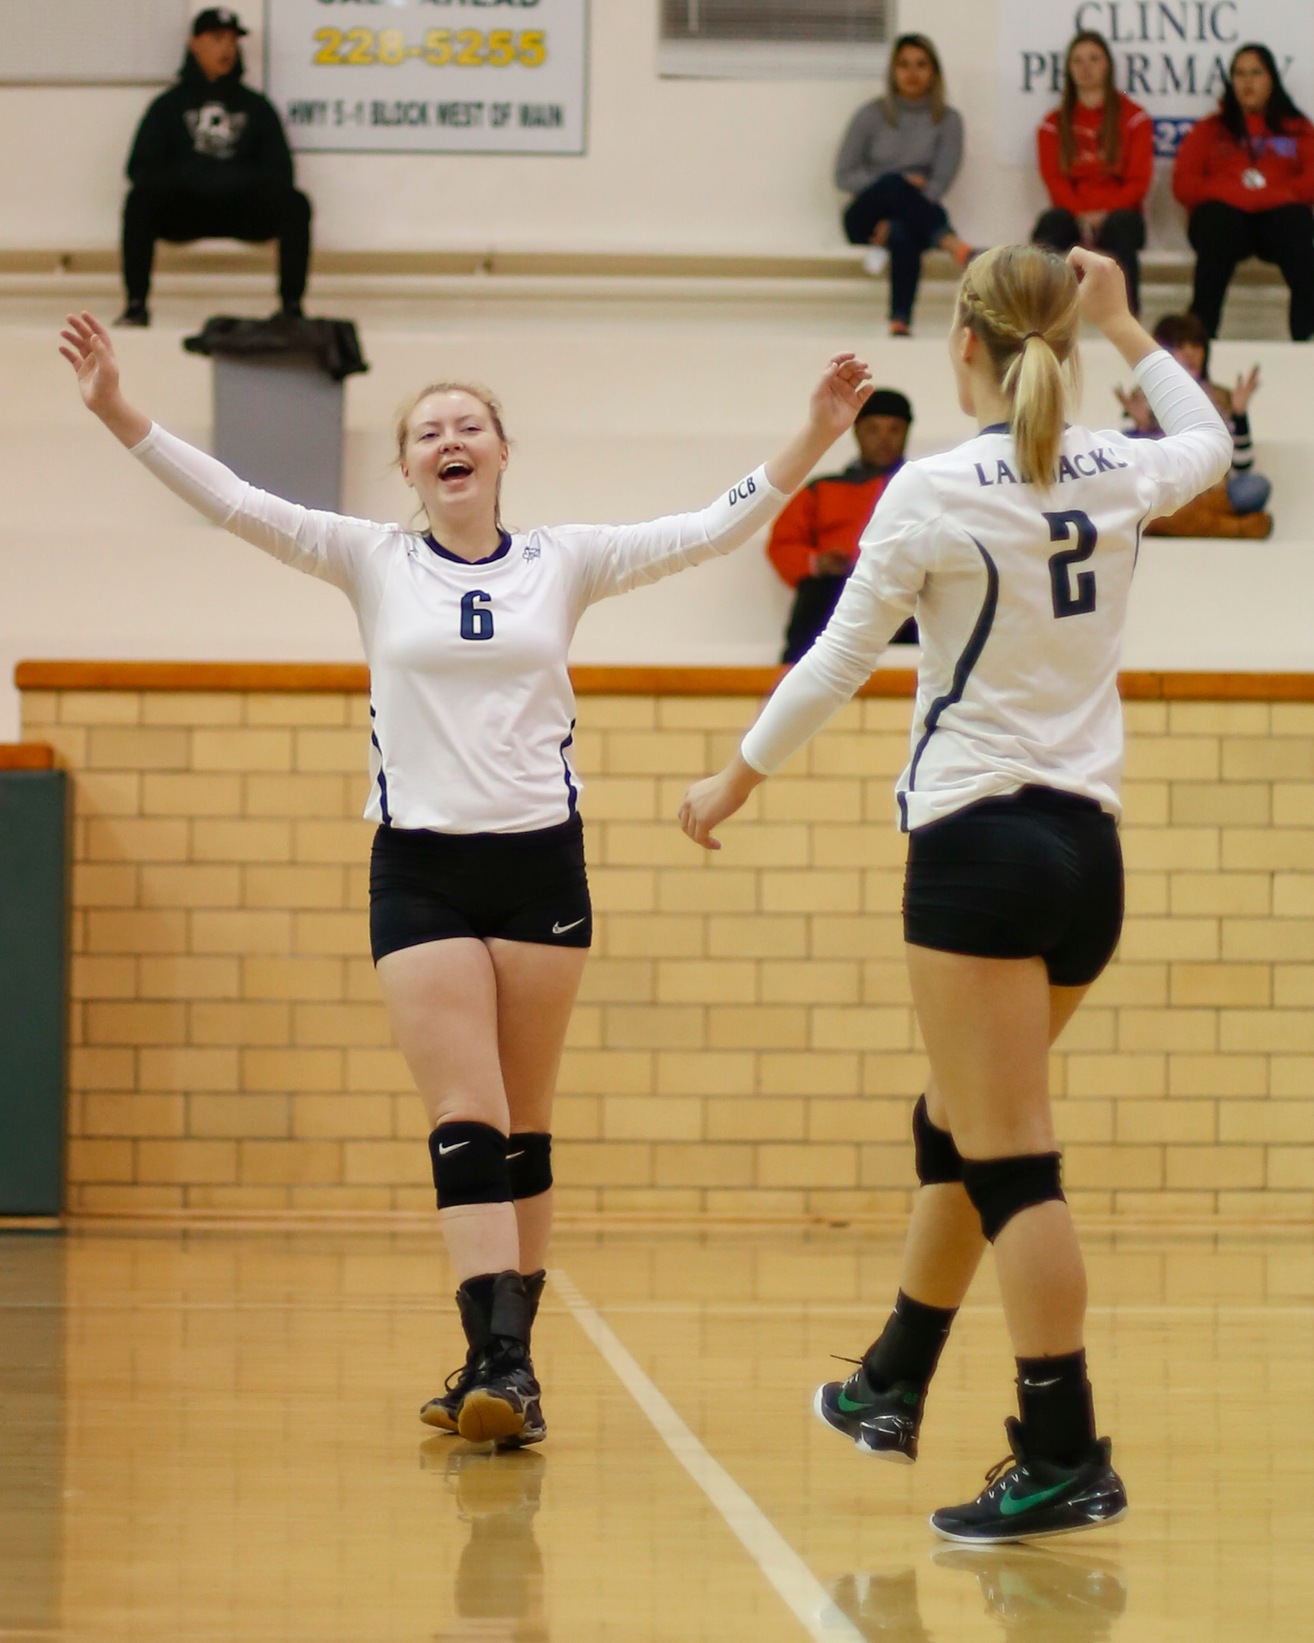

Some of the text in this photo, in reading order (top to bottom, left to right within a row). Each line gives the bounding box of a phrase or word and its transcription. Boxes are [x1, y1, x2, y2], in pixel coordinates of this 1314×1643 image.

[1075, 0, 1239, 42] CLINIC
[313, 26, 547, 67] 228-5255
[1021, 51, 1294, 96] PRMA
[370, 100, 427, 126] BLOCK
[437, 100, 484, 128] WEST
[491, 101, 512, 128] OF
[974, 447, 1128, 487] LAACK
[728, 476, 756, 507] DCB
[1042, 509, 1098, 619] 2
[460, 589, 494, 640] 6
